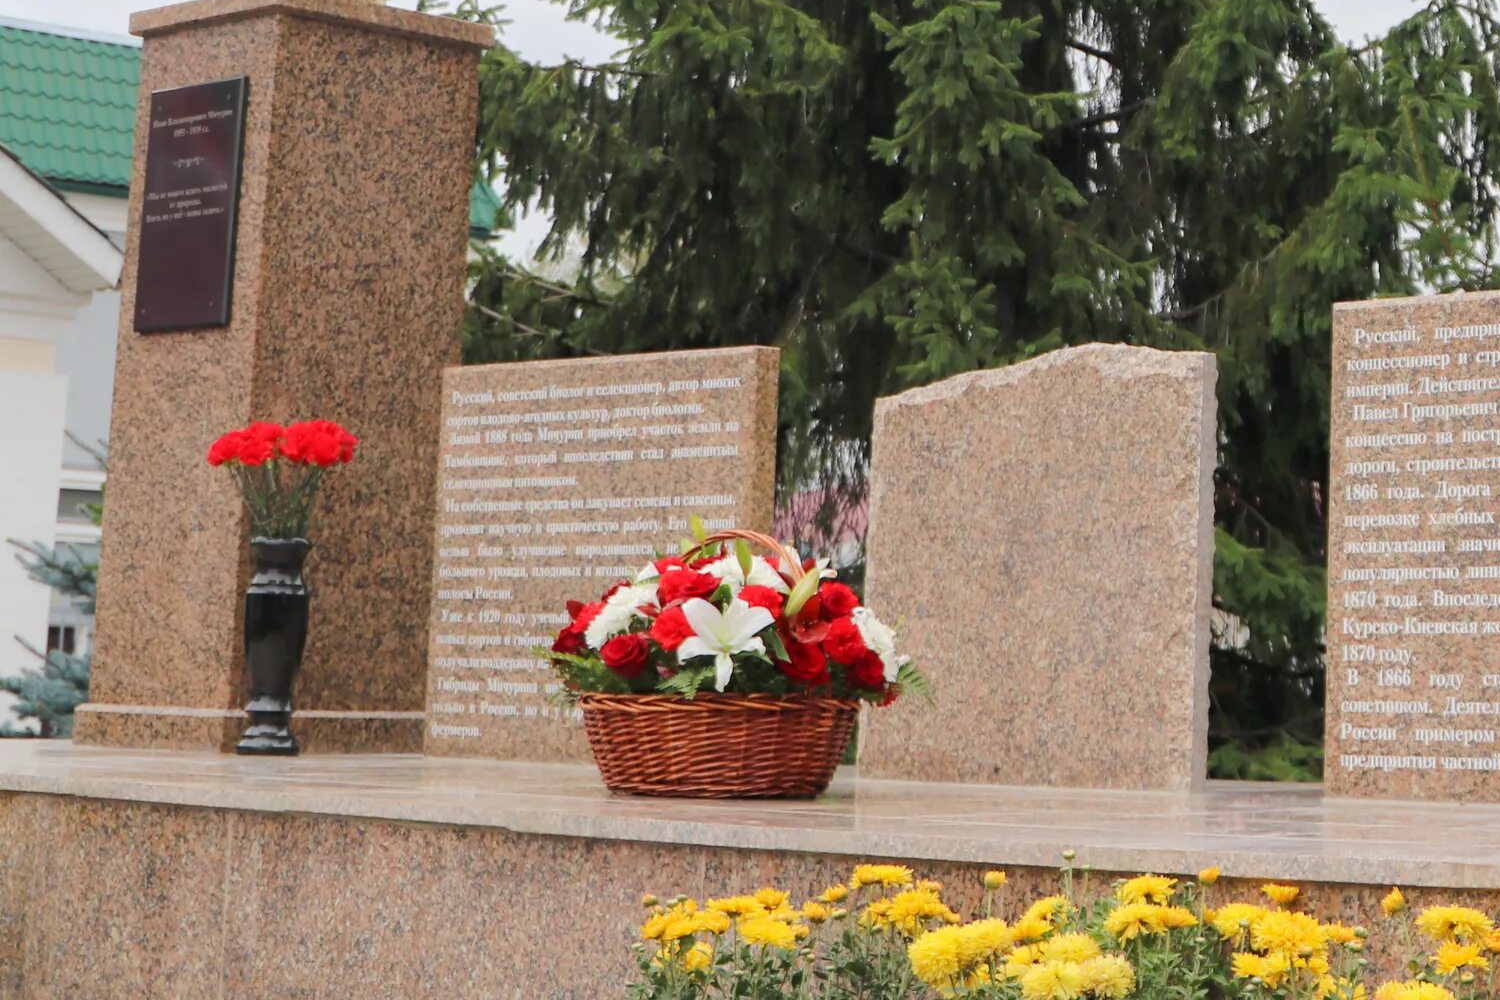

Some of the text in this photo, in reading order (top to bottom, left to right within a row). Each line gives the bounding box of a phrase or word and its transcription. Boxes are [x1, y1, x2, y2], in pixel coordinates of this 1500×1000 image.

[1354, 324, 1420, 349] Русский,
[1347, 351, 1450, 372] концессионер
[1459, 350, 1468, 364] и
[1347, 381, 1414, 400] империи.
[1352, 403, 1397, 421] Павел
[1402, 401, 1497, 423] Григорьевич
[1346, 430, 1426, 449] концессию
[1436, 429, 1452, 443] на
[1344, 459, 1400, 478] дороги,
[1345, 483, 1378, 501] 1866
[1387, 485, 1424, 502] года.
[1435, 480, 1490, 502] Дорога
[1344, 512, 1420, 531] перевозке
[1429, 506, 1494, 525] хлебных
[1344, 538, 1445, 558] эксплуатации
[1344, 566, 1458, 585] популярностью
[1344, 590, 1376, 608] 1870
[1385, 593, 1421, 610] года.
[1343, 617, 1477, 639] Курско-Киевская
[1343, 643, 1416, 665] 1870 году.
[1347, 668, 1358, 686] В
[1377, 668, 1411, 686] 1866
[1430, 672, 1463, 690] году
[1341, 699, 1432, 714] советником.
[1340, 722, 1396, 740] России
[1415, 727, 1494, 746] примером
[1340, 753, 1435, 773] предприятия
[1441, 752, 1500, 770] частной
